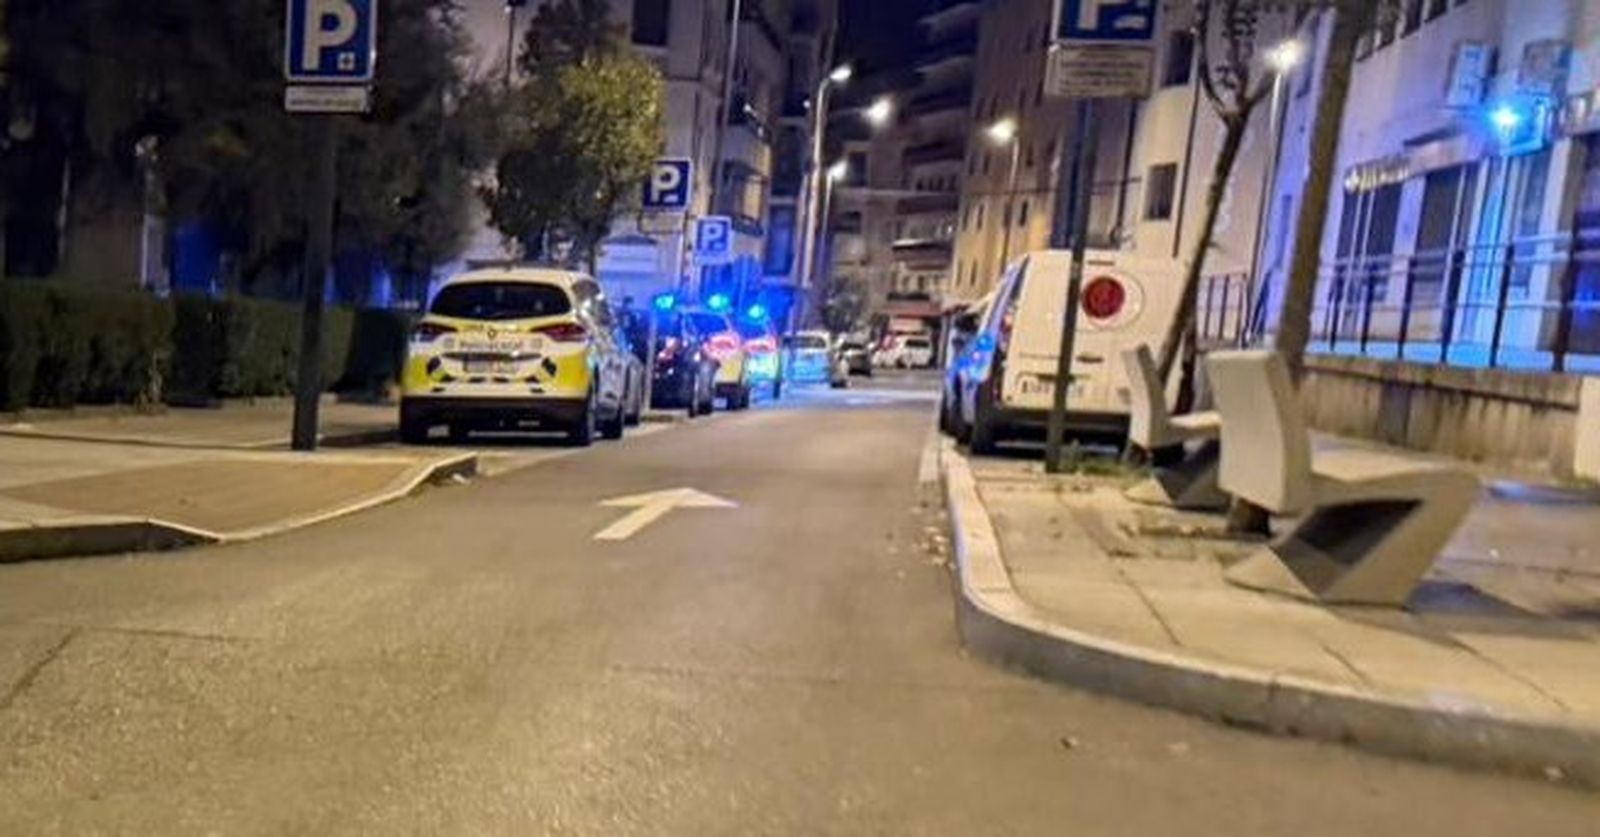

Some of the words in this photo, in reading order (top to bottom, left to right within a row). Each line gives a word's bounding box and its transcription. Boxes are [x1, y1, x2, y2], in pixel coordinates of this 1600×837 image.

[302, 0, 358, 70] P
[650, 164, 681, 203] P
[702, 222, 724, 251] P
